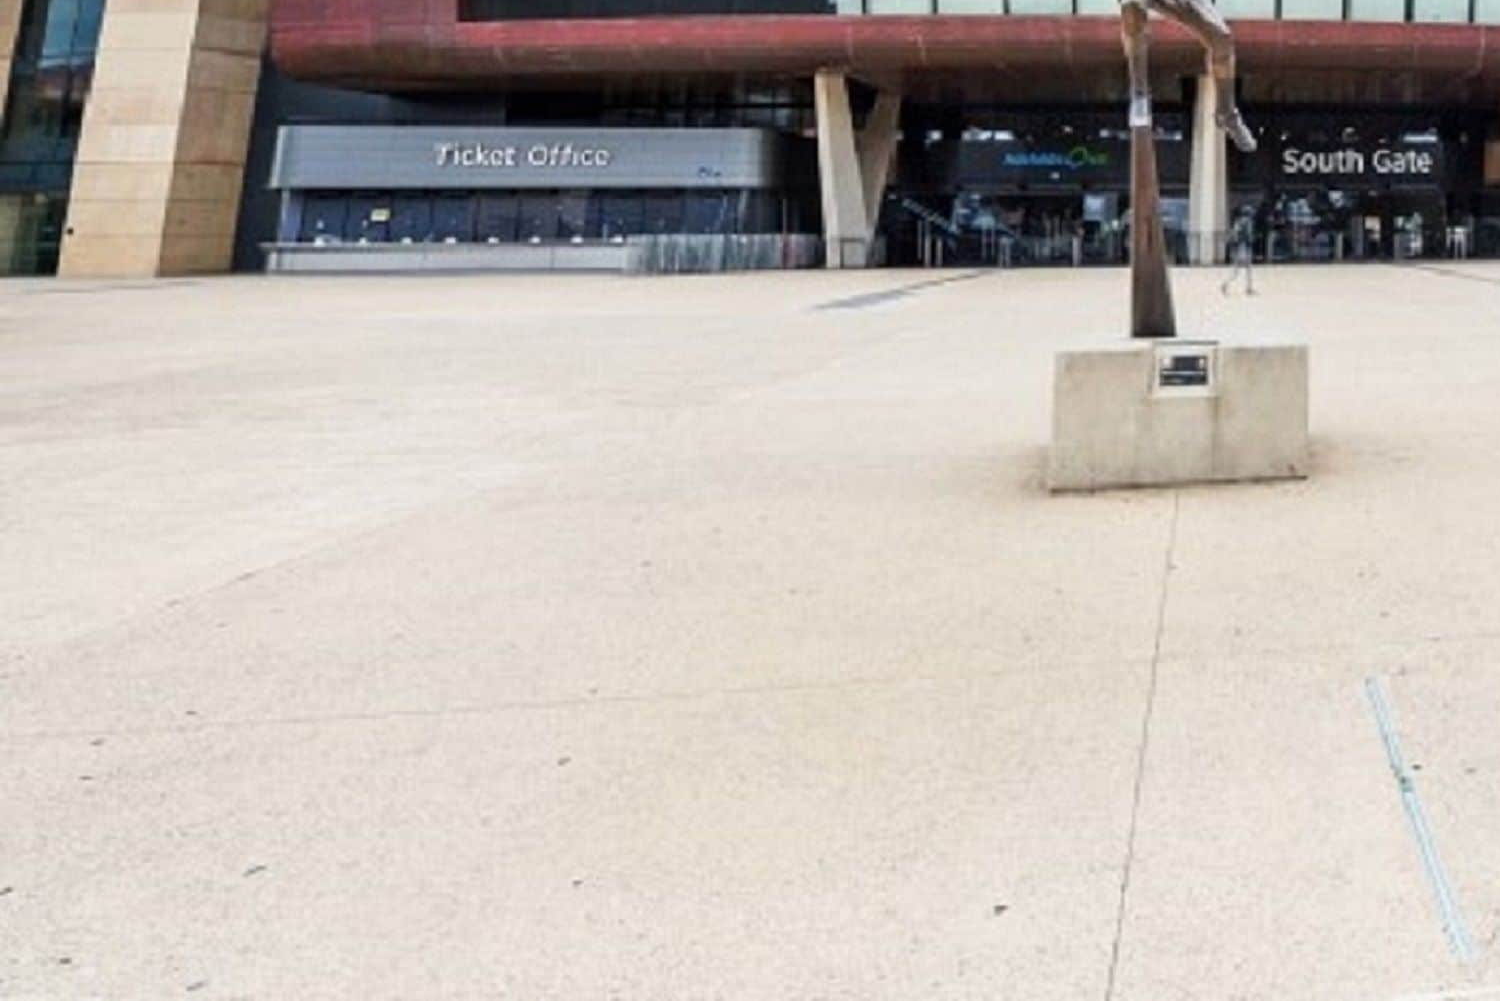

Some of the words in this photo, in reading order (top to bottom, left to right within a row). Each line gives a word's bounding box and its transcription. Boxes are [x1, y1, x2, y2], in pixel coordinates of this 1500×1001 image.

[435, 142, 516, 167] Ticket
[527, 142, 611, 167] Office
[1282, 148, 1365, 175] South
[1372, 148, 1434, 175] Gate
